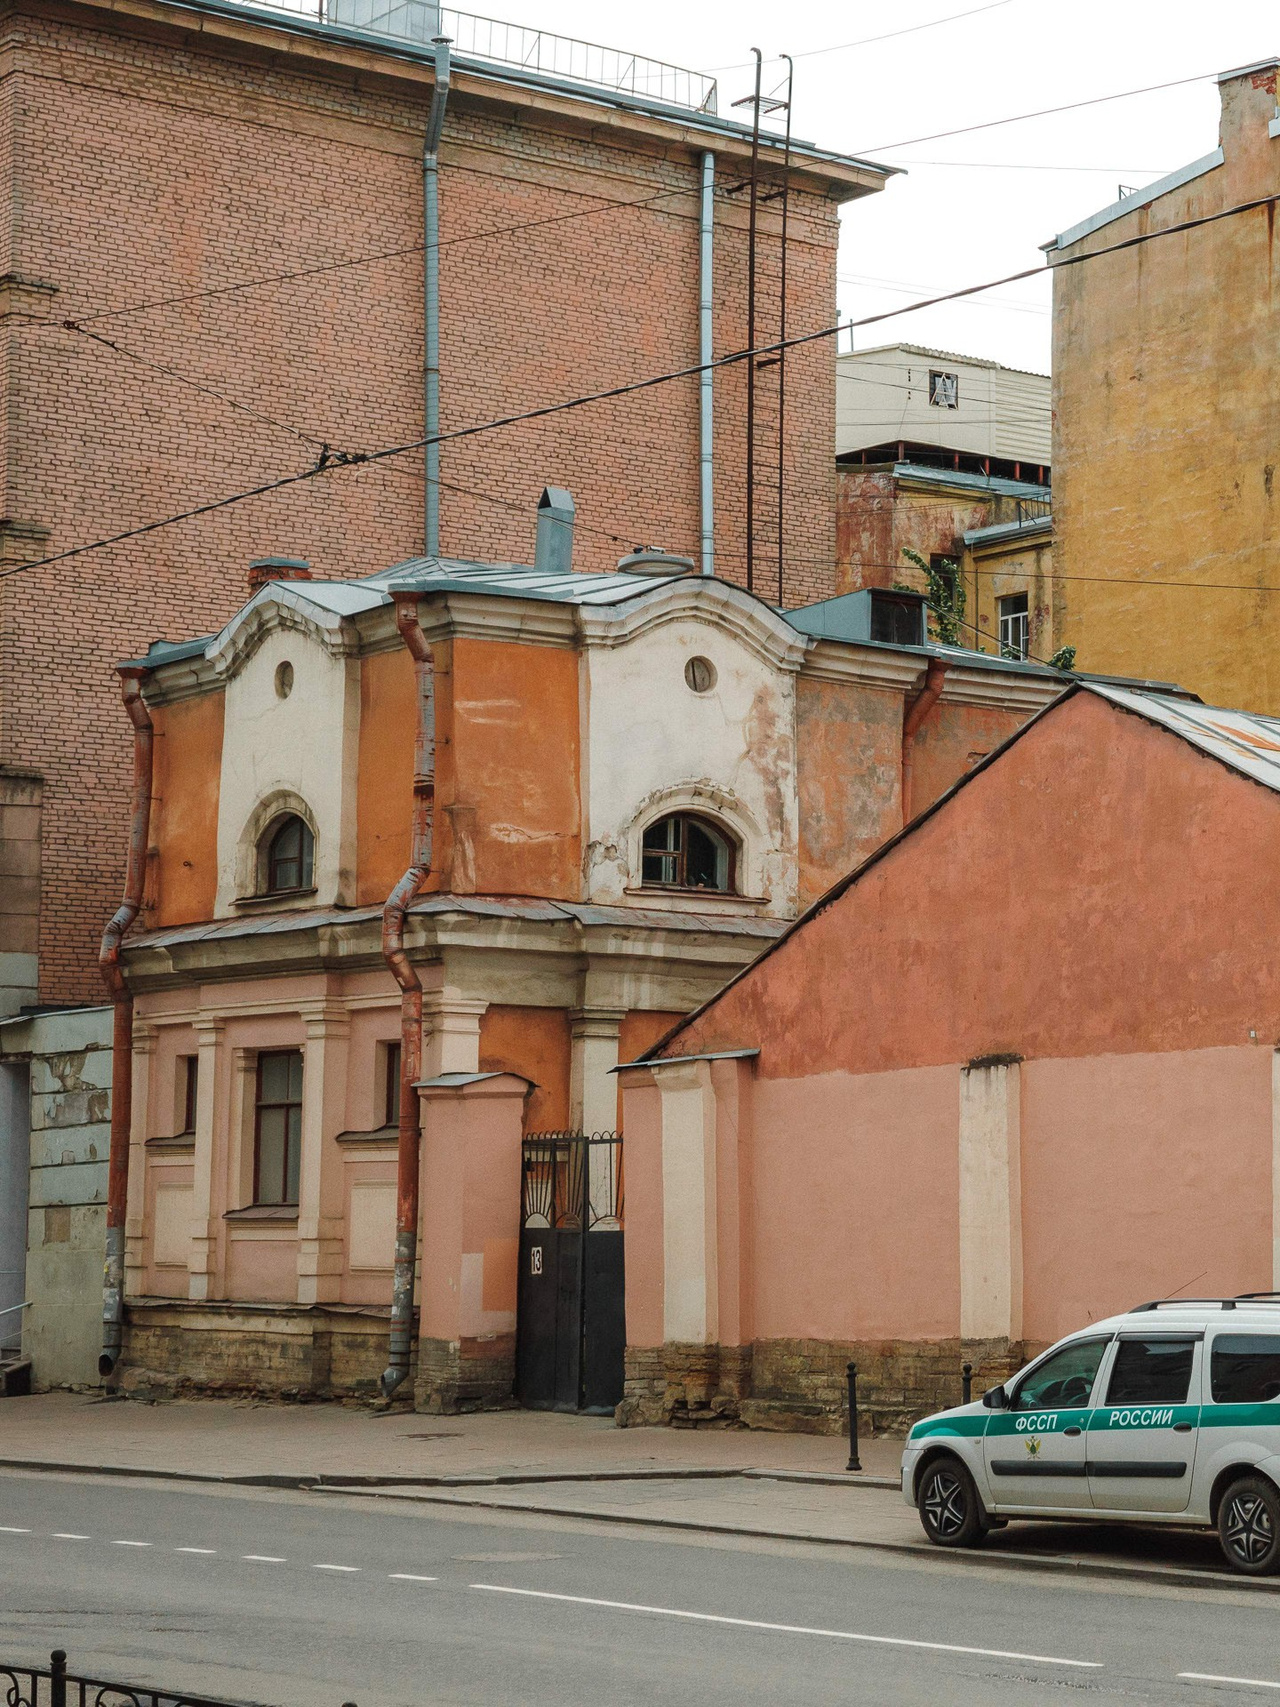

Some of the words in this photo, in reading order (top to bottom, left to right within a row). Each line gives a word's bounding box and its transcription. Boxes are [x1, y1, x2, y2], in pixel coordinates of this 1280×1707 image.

[532, 1249, 541, 1272] 13
[1015, 1414, 1058, 1432] ФССП
[1109, 1409, 1174, 1427] РОССИИ
